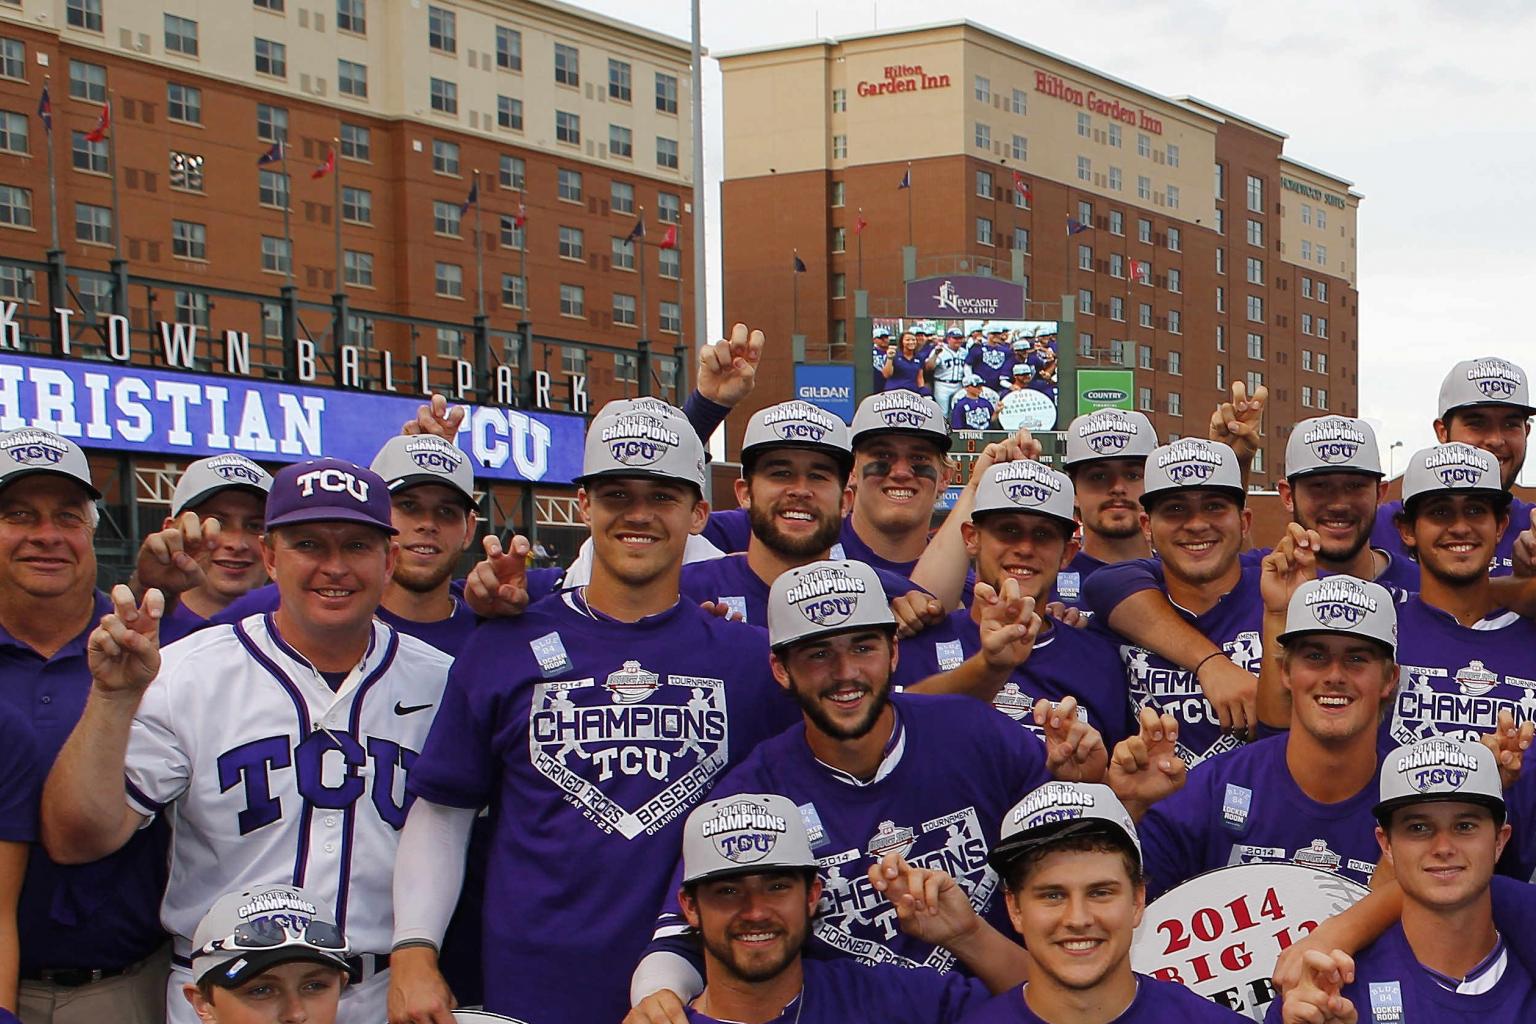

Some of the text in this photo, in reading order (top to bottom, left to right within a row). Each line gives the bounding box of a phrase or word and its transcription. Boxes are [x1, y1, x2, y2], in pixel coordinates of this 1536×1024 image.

[884, 64, 922, 79] Hilton
[857, 72, 951, 98] Garden Inn
[1034, 70, 1163, 136] Hilton Garden Inn
[0, 302, 250, 375] KTOWN
[297, 339, 588, 412] BALLPARK
[800, 386, 849, 398] GILDAN
[1087, 391, 1122, 399] COUNTRY
[762, 409, 834, 433] CHAMPIONS
[601, 424, 680, 448] CHAMPIONS
[959, 432, 983, 440] STRIKE
[611, 440, 668, 461] TCU
[296, 469, 370, 503] TCU
[786, 577, 865, 604] CHAMPIONS
[1304, 586, 1377, 612] CHAMPIONS
[804, 597, 859, 622] TCU
[1315, 604, 1364, 624] TCU
[532, 703, 726, 744] CHAMPIONS
[593, 746, 671, 784] TCU
[1397, 752, 1478, 777] CHAMPIONS
[217, 729, 412, 835] TCU
[1413, 768, 1464, 789] TCU
[636, 757, 725, 827] BASEBALL
[702, 814, 787, 838] CHAMPIONS
[720, 833, 771, 856] TCU
[1156, 887, 1286, 955] 2014
